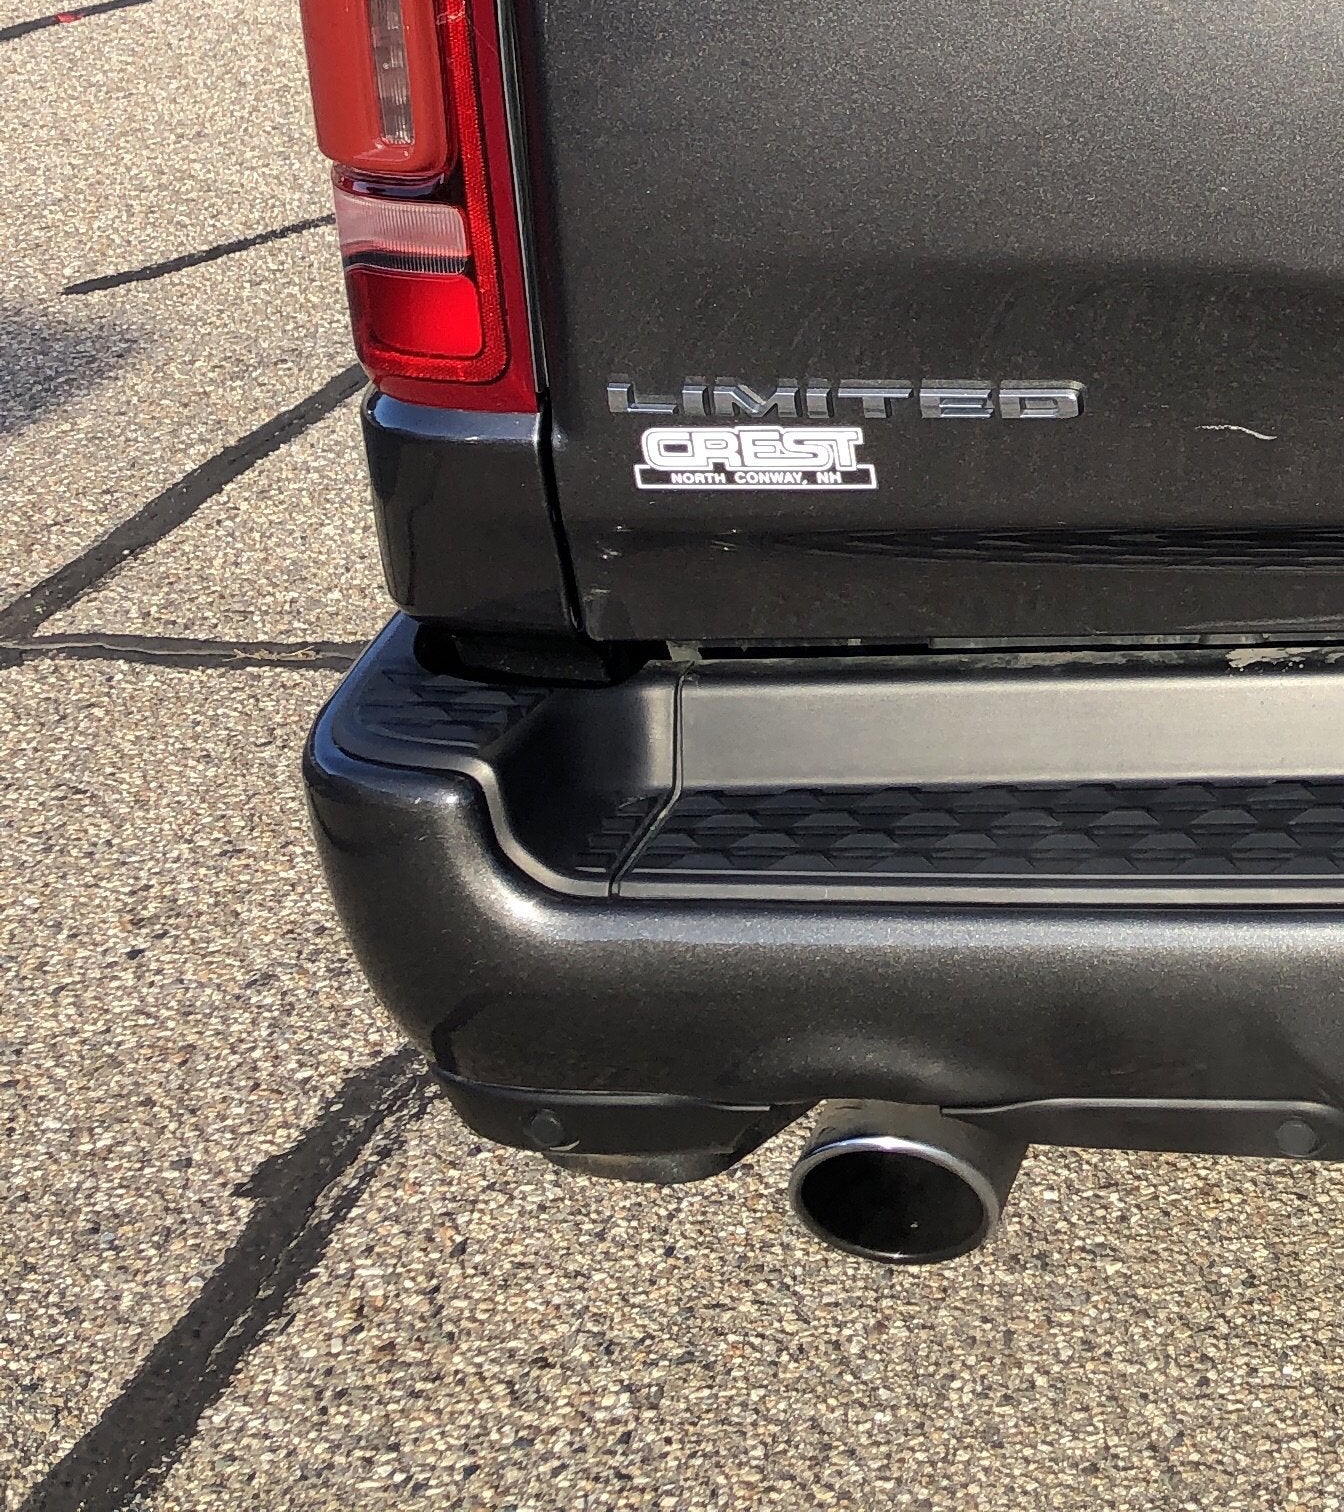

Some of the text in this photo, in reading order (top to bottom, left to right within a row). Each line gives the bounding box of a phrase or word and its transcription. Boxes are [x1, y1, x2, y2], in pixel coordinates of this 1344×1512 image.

[606, 372, 1086, 419] LIMITED
[641, 425, 864, 471] CREST
[670, 471, 842, 486] NORTH CONWAY, NH
